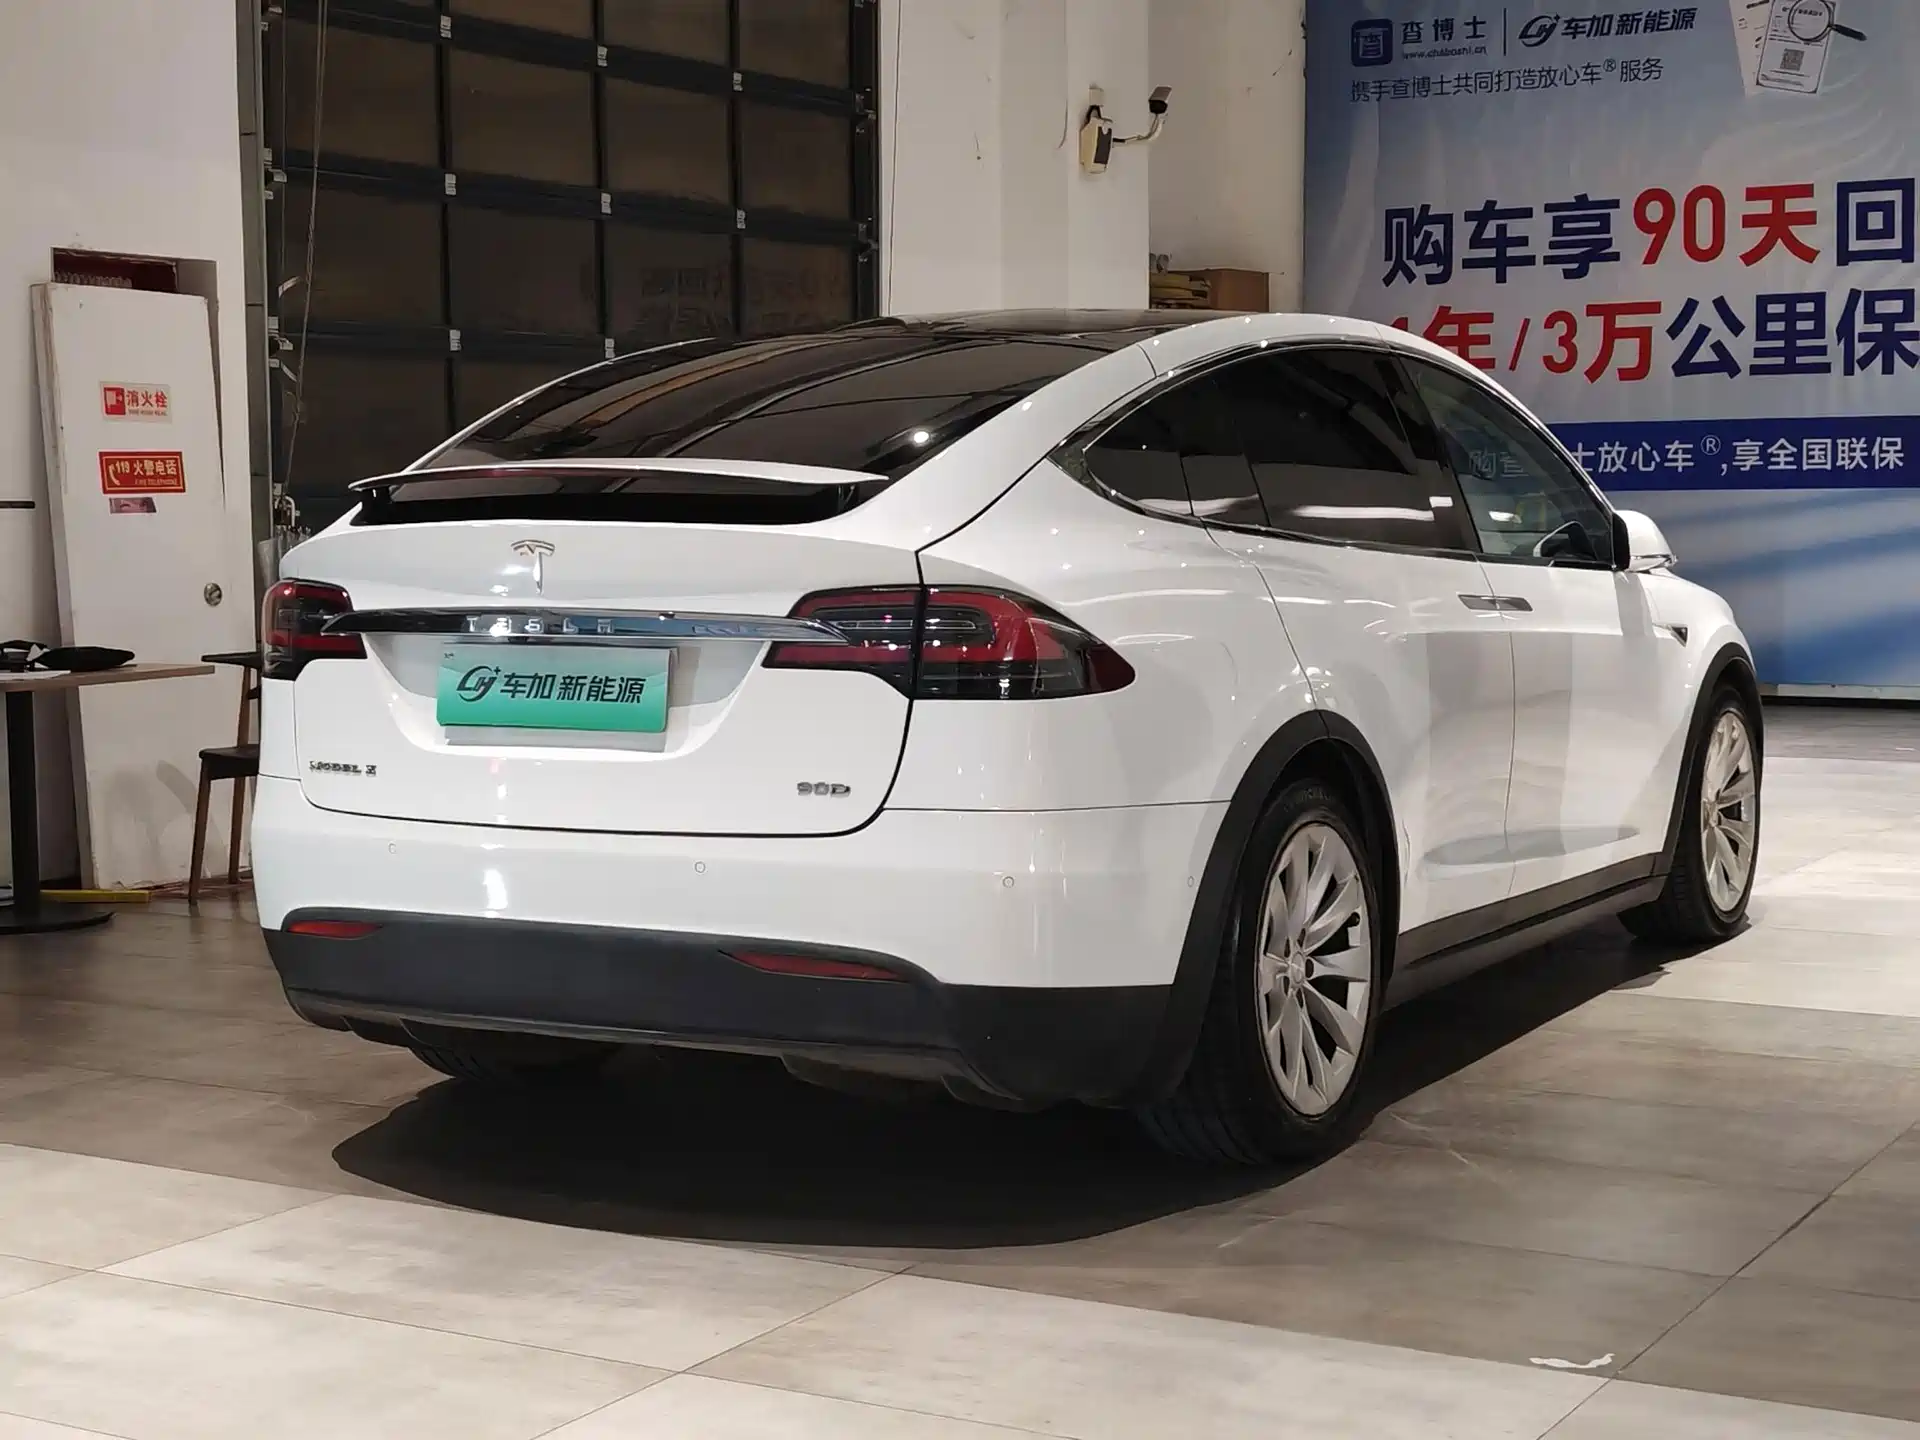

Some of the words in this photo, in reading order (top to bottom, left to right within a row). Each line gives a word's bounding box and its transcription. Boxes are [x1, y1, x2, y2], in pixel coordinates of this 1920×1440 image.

[1401, 15, 1487, 45] 查博士
[1561, 7, 1698, 40] 车加新能源
[1382, 177, 1917, 288] 购车享90天回
[1391, 288, 1920, 384] 年/3万公里保
[126, 390, 168, 409] 消火栓
[133, 460, 177, 476] 火警电话
[500, 672, 647, 704] 车加新能源
